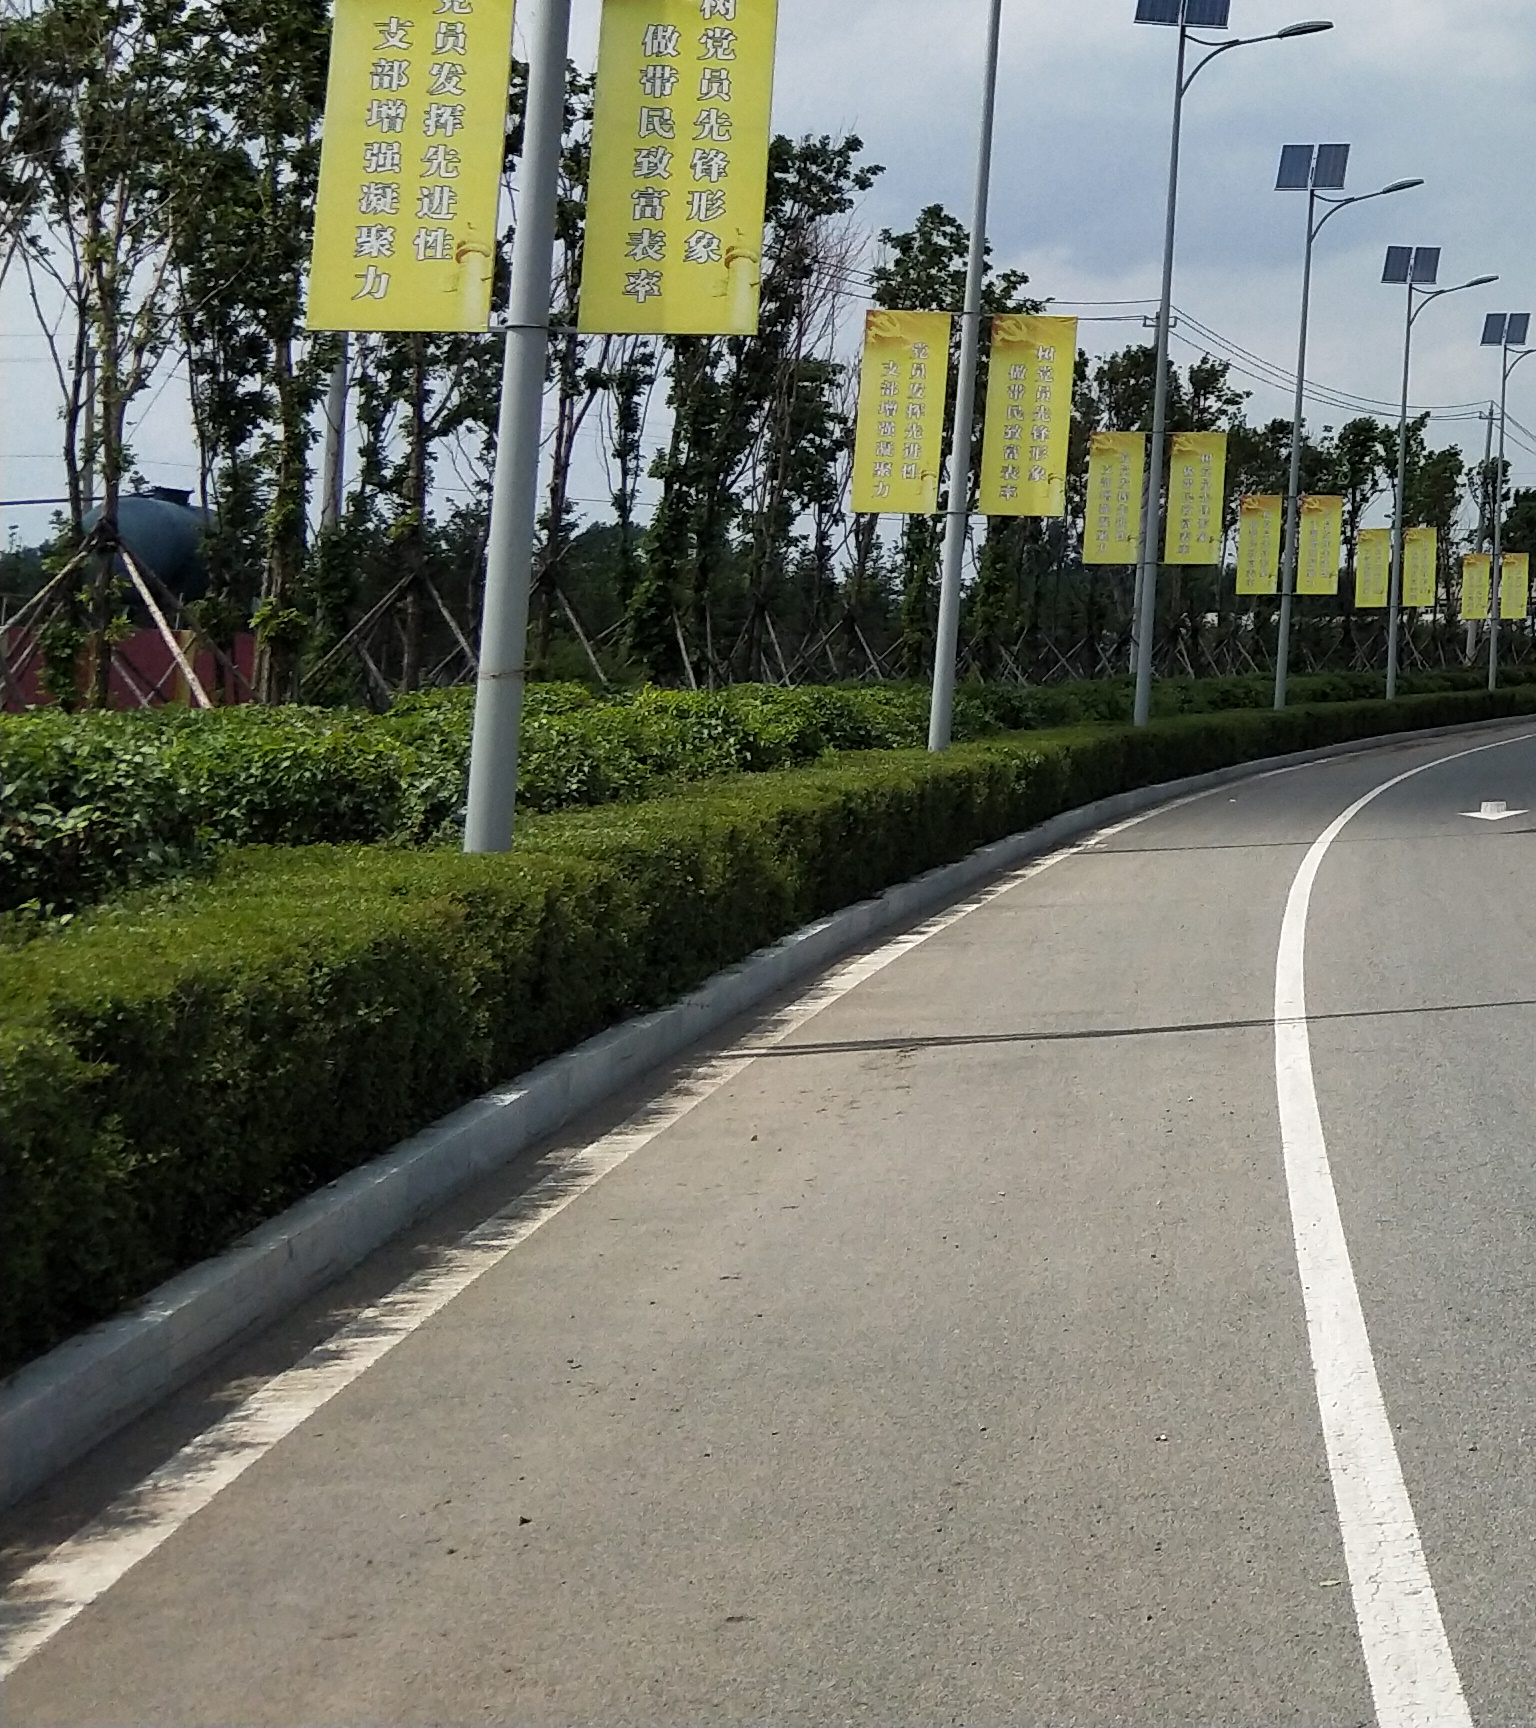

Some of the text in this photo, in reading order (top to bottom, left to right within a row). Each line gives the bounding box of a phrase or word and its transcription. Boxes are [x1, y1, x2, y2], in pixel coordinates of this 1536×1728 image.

[351, 16, 414, 301] 支部增强凝聚力
[623, 23, 680, 303] 做带民致富表率
